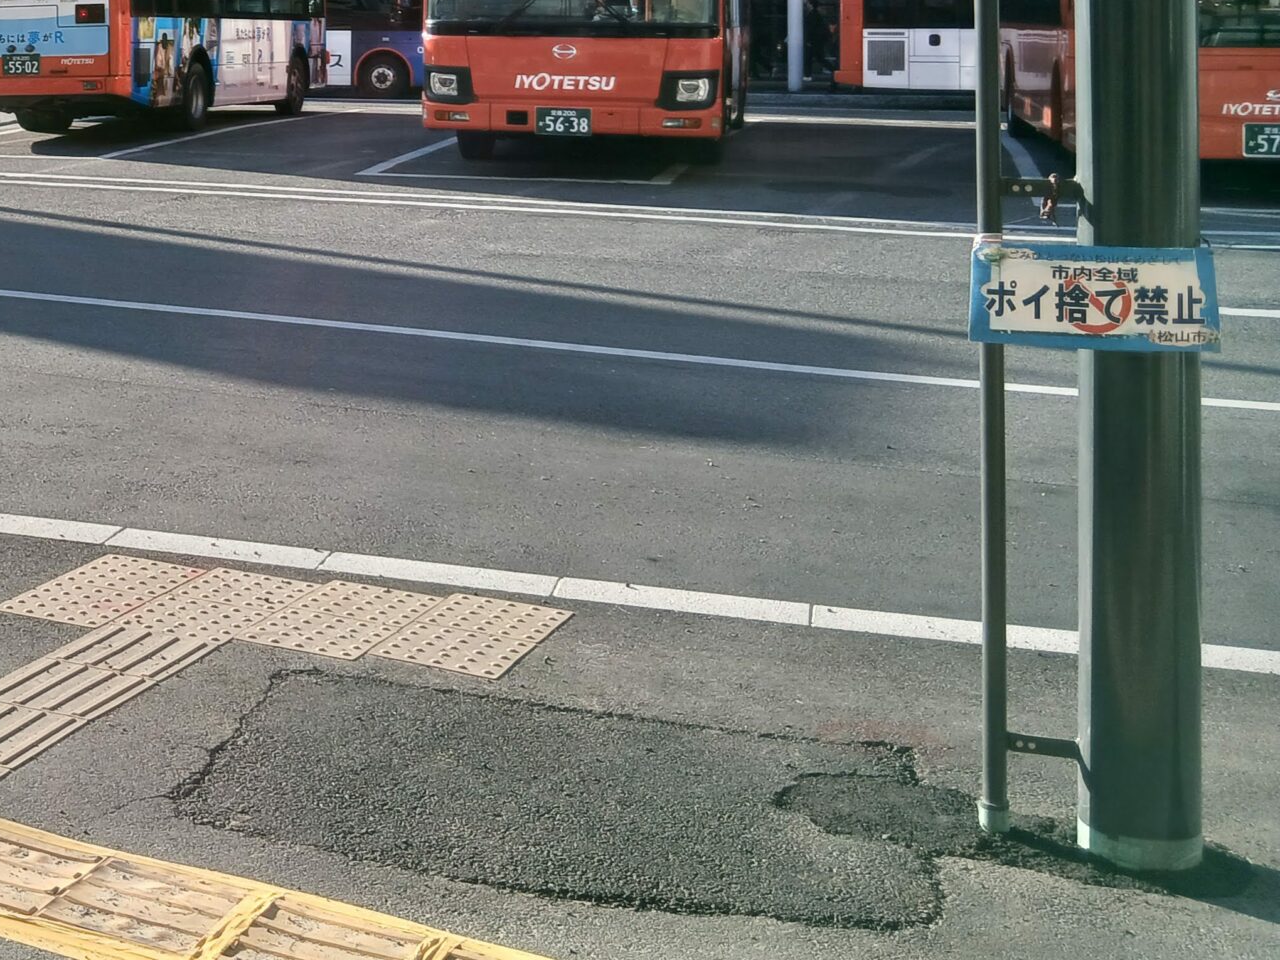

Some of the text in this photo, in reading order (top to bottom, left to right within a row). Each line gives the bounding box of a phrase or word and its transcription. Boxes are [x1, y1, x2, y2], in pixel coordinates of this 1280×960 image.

[514, 72, 616, 91] IYOTETSU
[544, 115, 589, 133] 56-38
[1051, 265, 1139, 282] 市内全域
[985, 280, 1206, 325] ポイ捨て禁止
